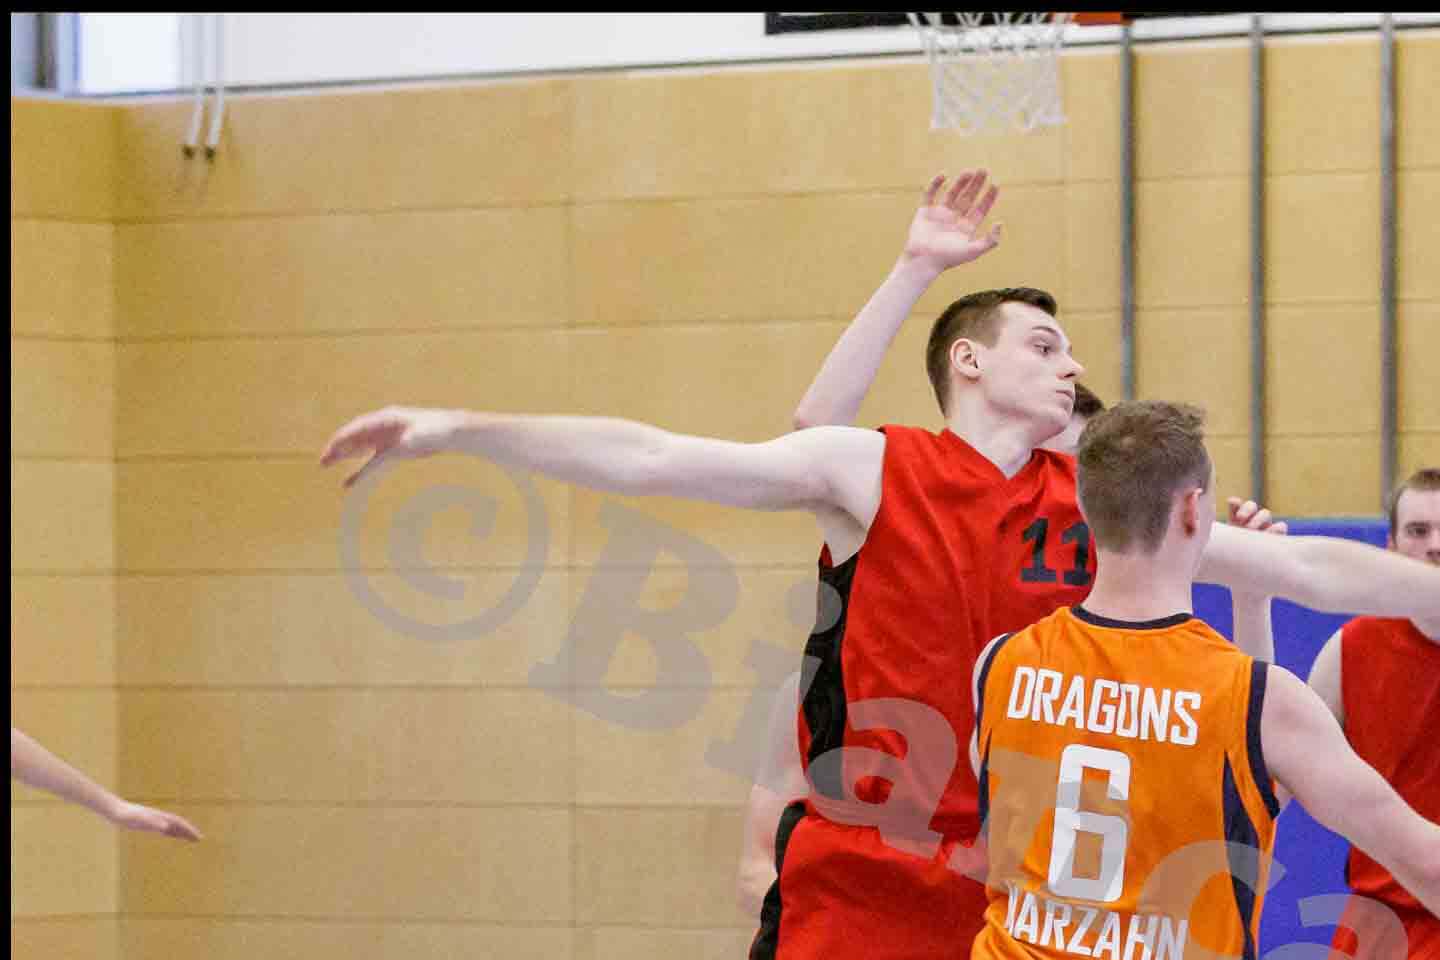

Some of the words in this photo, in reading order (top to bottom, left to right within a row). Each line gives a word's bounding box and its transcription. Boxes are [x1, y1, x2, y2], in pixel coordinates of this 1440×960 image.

[1021, 517, 1091, 586] 11
[1007, 666, 1201, 746] DRAGONS
[1048, 743, 1131, 902] 6
